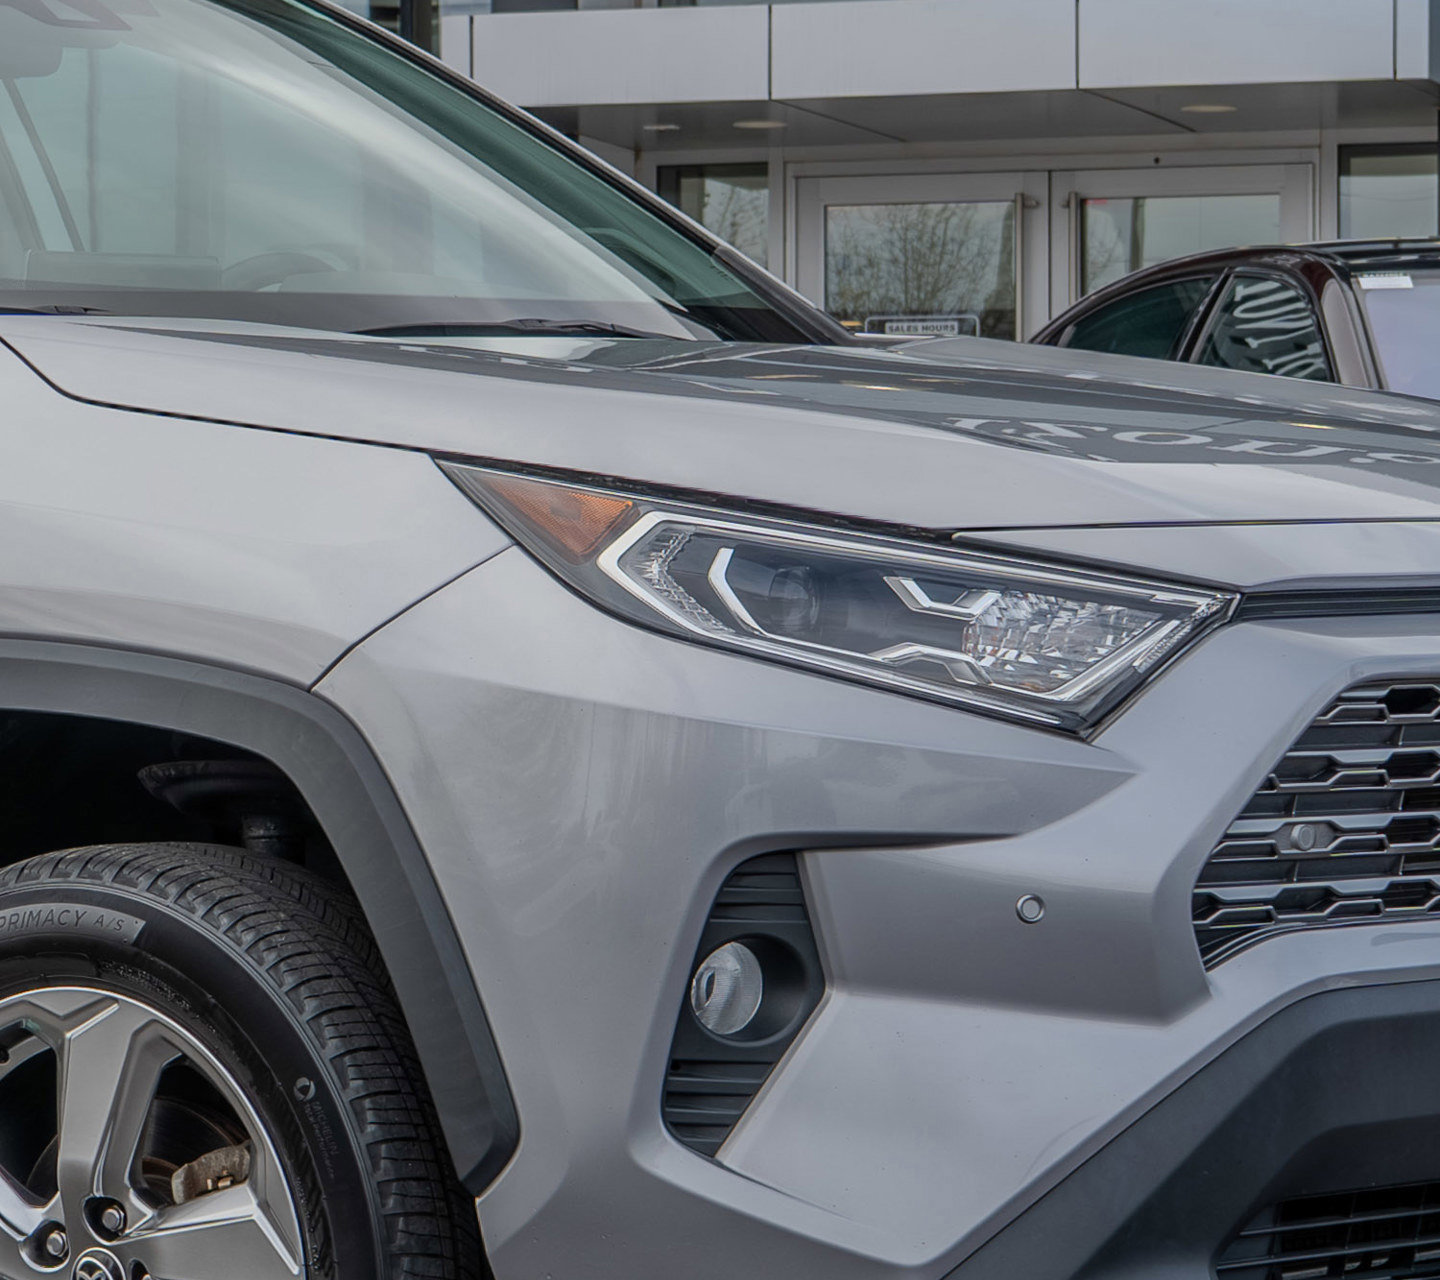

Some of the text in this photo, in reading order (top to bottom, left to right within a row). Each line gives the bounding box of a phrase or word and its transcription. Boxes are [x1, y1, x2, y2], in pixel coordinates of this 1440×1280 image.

[888, 324, 956, 333] SALES HOURS
[93, 914, 124, 931] A/S
